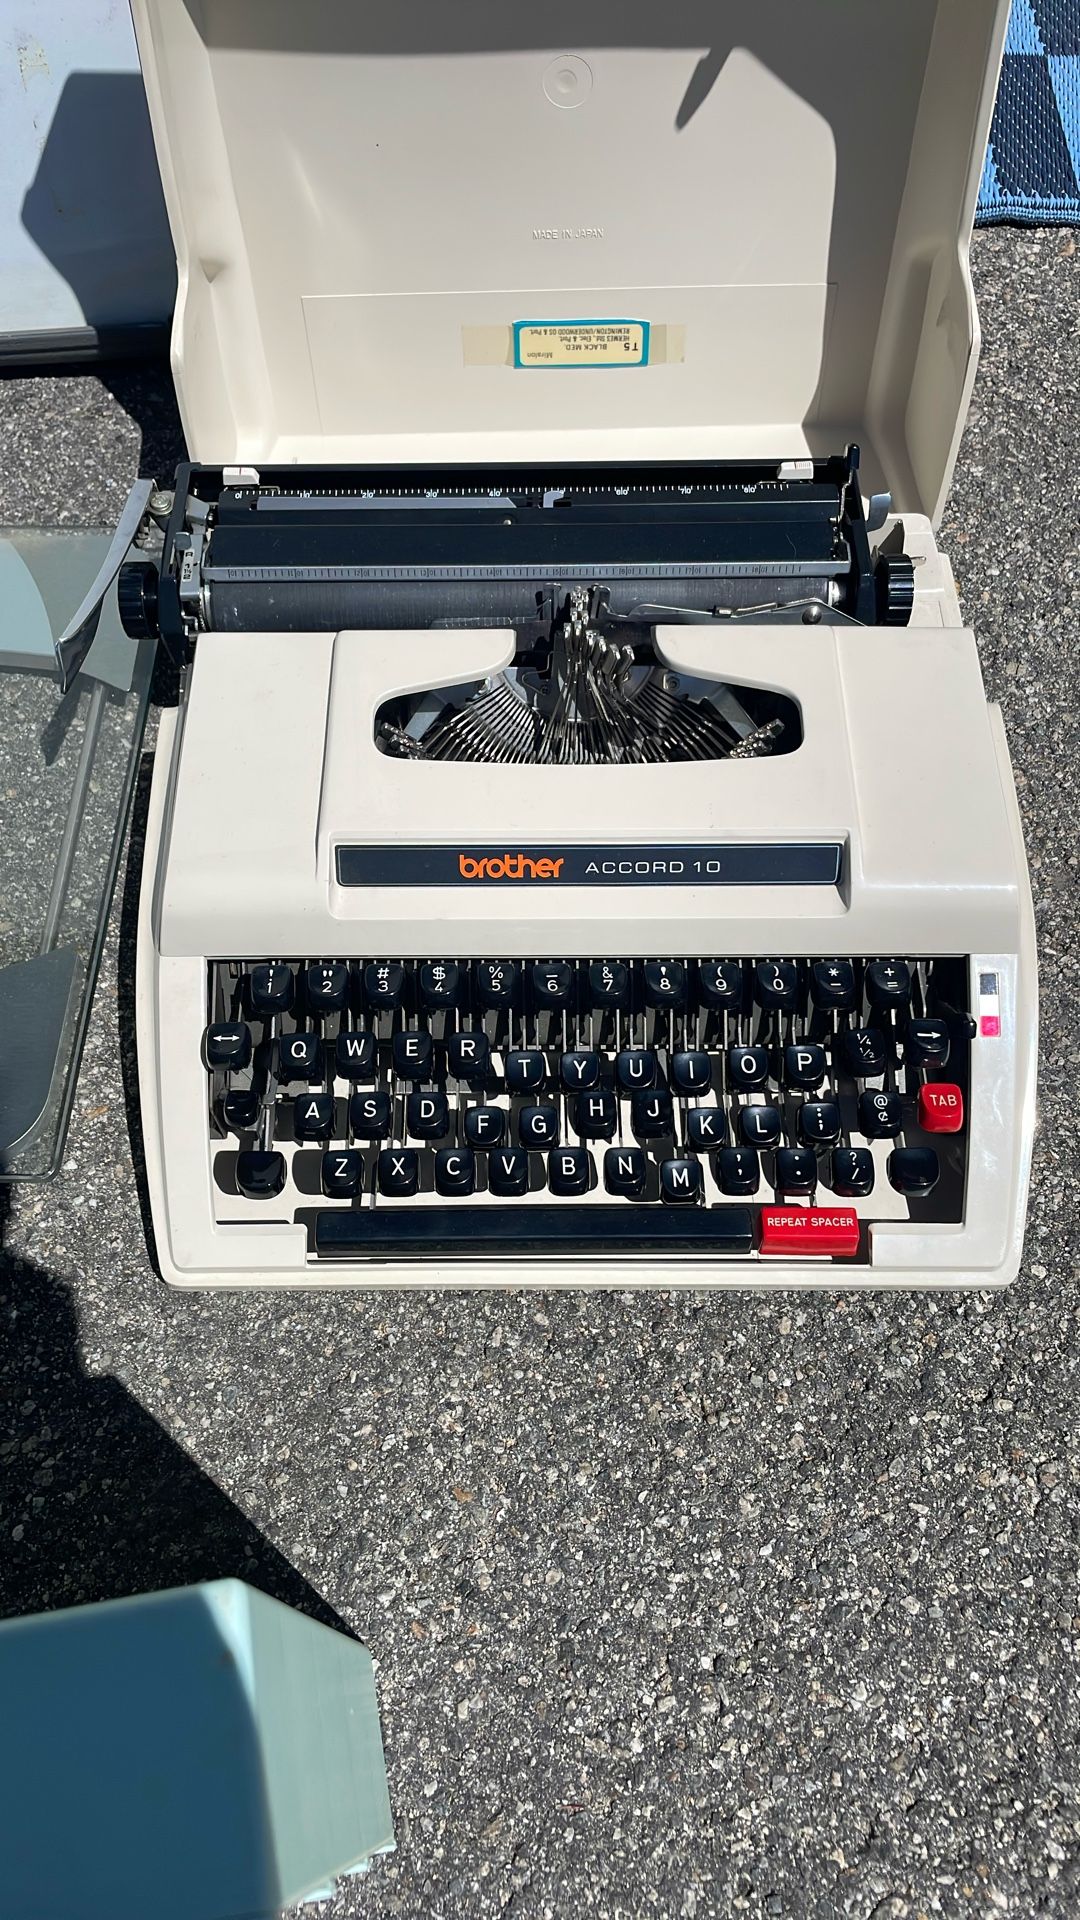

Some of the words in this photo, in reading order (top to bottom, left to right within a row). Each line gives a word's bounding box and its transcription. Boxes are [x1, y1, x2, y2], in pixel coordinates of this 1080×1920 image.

[532, 229, 559, 240] MADE
[561, 229, 572, 240] IN
[575, 227, 604, 239] JAPAN
[557, 327, 630, 336] REMINGTON/UNDERWOOD
[583, 343, 608, 351] BLACK
[526, 351, 553, 359] Miralon
[361, 491, 374, 499] 20
[459, 854, 565, 879] brother
[584, 861, 684, 874] ACCORD
[693, 860, 721, 873] 10
[376, 967, 390, 979] #
[432, 966, 446, 981] $
[488, 965, 504, 979] %
[602, 966, 614, 979] &
[884, 967, 895, 977] +
[321, 980, 333, 993] 2
[377, 980, 389, 992] 3
[434, 981, 444, 993] 4
[491, 979, 501, 992] 5
[547, 979, 559, 992] 6
[602, 979, 614, 992] 7
[659, 977, 671, 990] 8
[715, 978, 727, 991] 9
[772, 978, 785, 991] 0
[290, 1040, 307, 1059] Q
[346, 1038, 365, 1057] W
[405, 1038, 419, 1057] E
[460, 1039, 476, 1057] R
[517, 1058, 531, 1078] T
[573, 1059, 587, 1079] Y
[629, 1058, 643, 1078] U
[688, 1060, 694, 1080] I
[740, 1054, 757, 1074] O
[797, 1052, 813, 1072] P
[873, 1094, 888, 1110] @
[304, 1101, 320, 1119] A
[363, 1100, 377, 1118] S
[420, 1099, 435, 1118] D
[477, 1114, 490, 1134] F
[531, 1114, 547, 1134] G
[589, 1098, 604, 1117] H
[646, 1099, 660, 1117] J
[699, 1114, 714, 1135] K
[755, 1113, 768, 1133] L
[929, 1094, 957, 1106] TAB
[849, 1151, 858, 1166] ?
[334, 1158, 349, 1177] Z
[391, 1156, 405, 1176] X
[446, 1156, 461, 1176] C
[501, 1155, 516, 1175] V
[561, 1156, 576, 1176] B
[618, 1155, 633, 1175] N
[672, 1168, 689, 1188] M
[767, 1217, 808, 1227] REPEAT
[810, 1217, 854, 1227] SPACER
